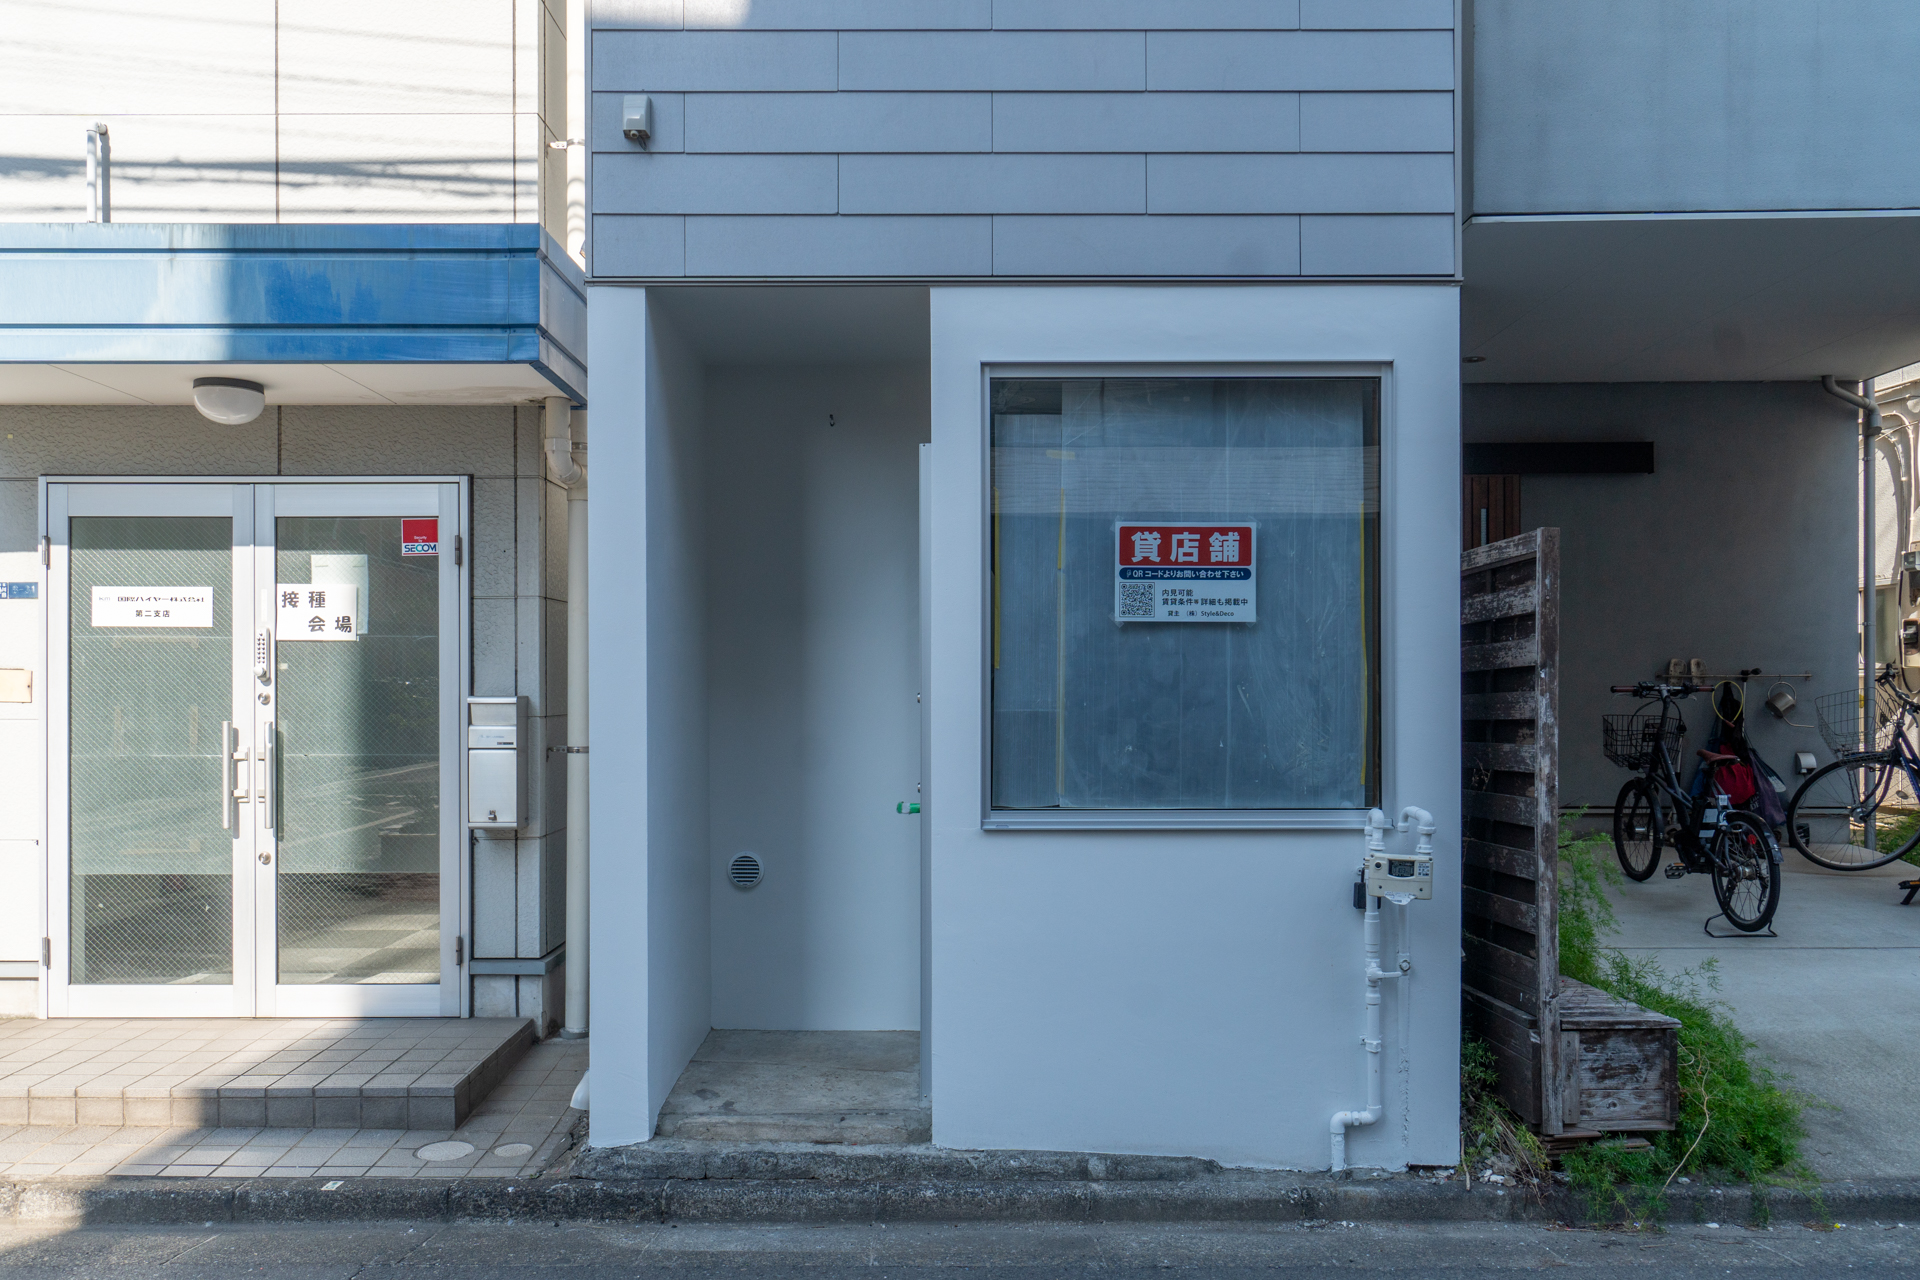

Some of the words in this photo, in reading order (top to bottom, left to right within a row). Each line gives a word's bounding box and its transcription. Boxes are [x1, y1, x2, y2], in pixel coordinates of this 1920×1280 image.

[404, 544, 437, 552] SECOM
[1131, 531, 1240, 562] 貸店舗
[1162, 589, 1193, 597] 内見可能
[281, 591, 326, 608] 接種
[135, 610, 170, 618] 第二支店
[308, 615, 352, 633] 会場
